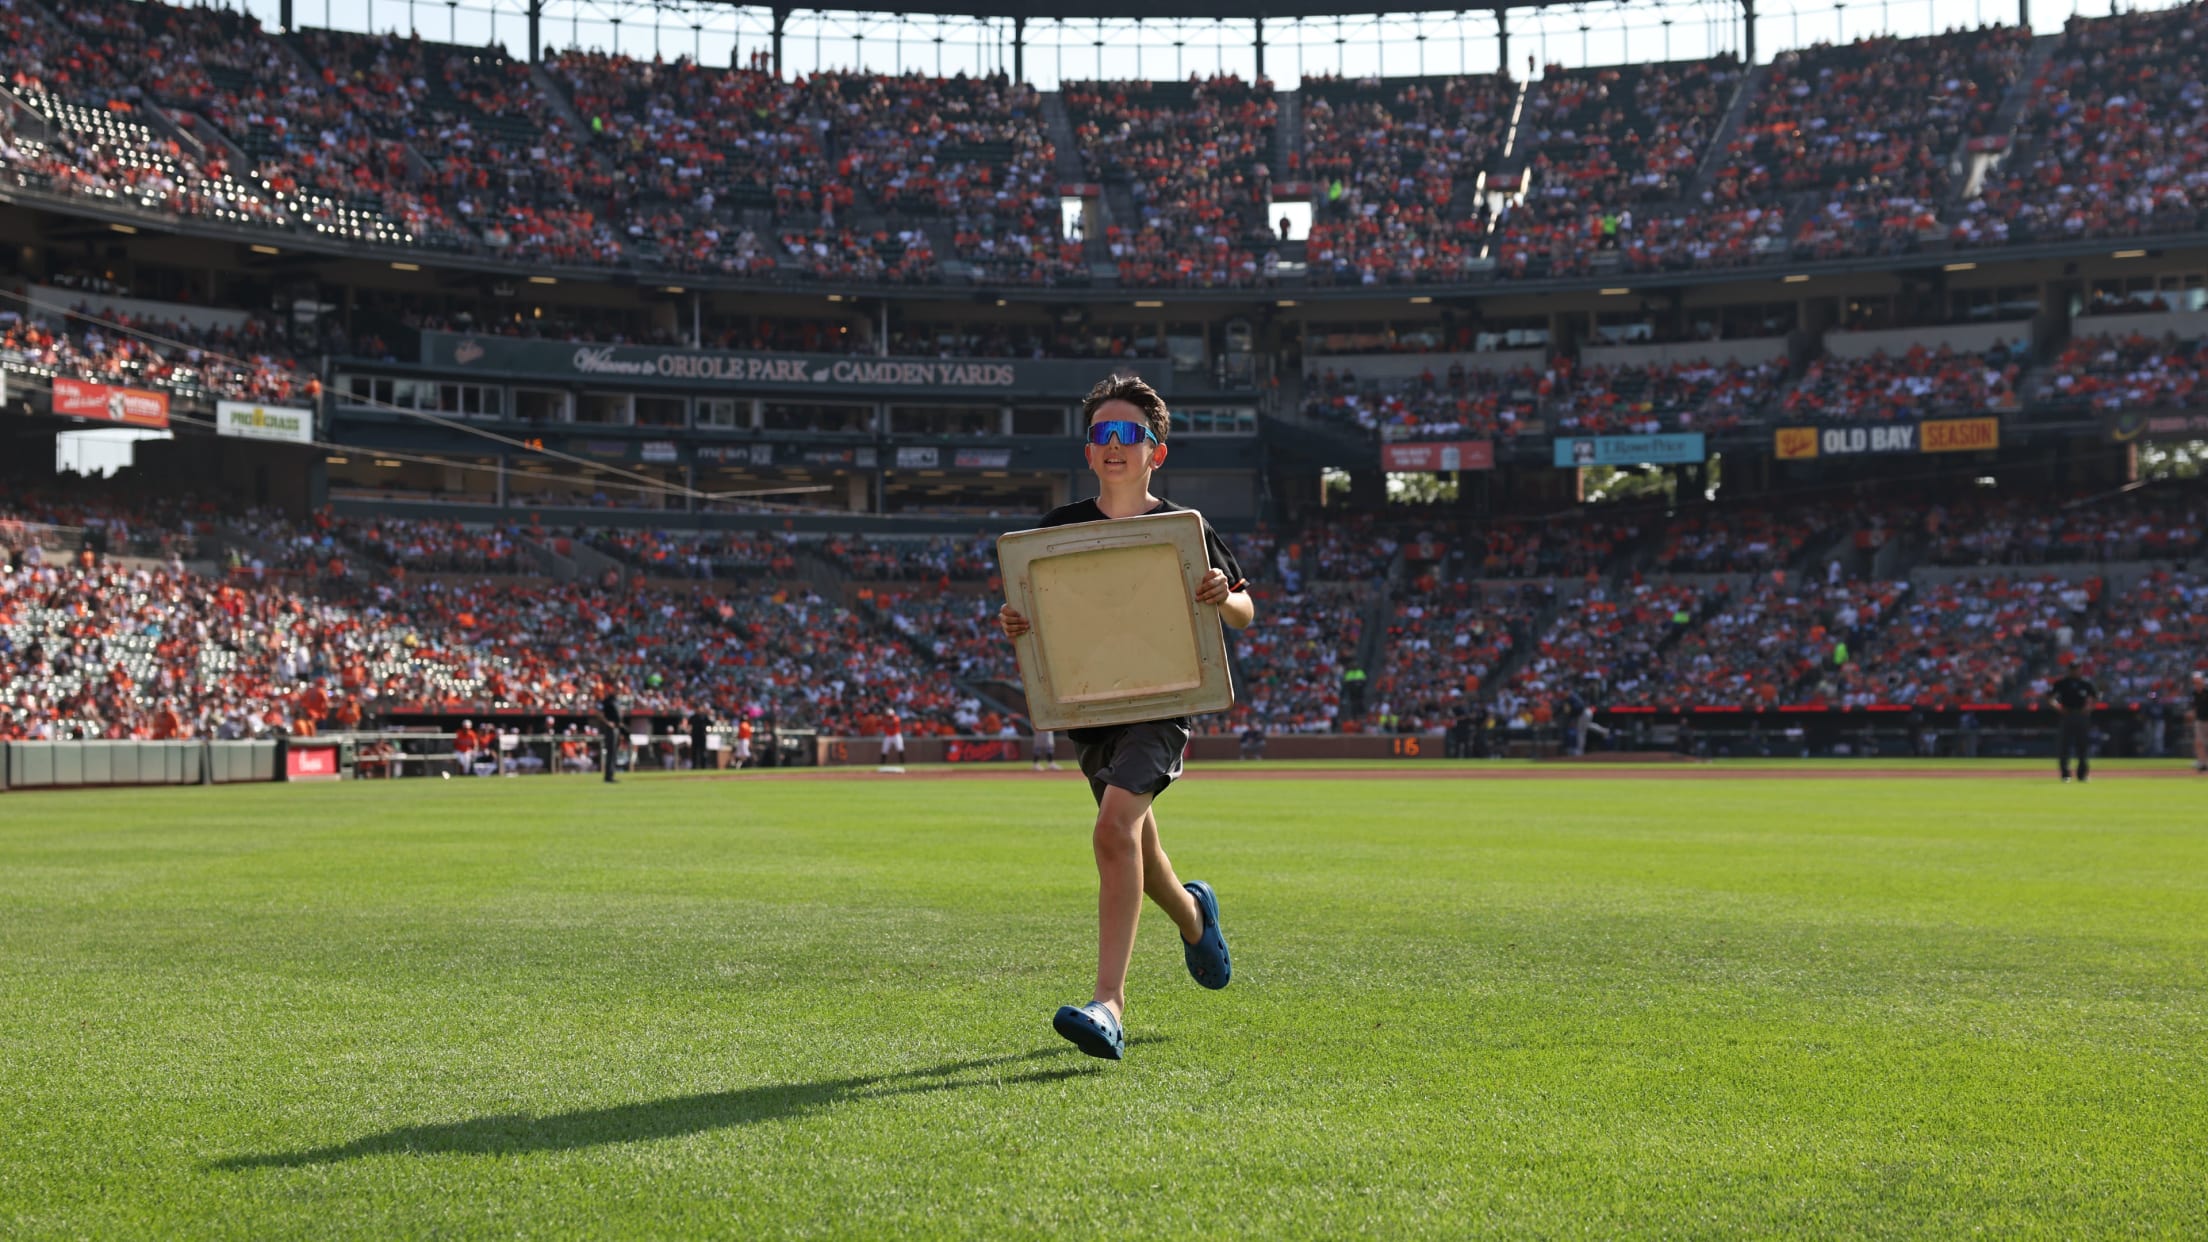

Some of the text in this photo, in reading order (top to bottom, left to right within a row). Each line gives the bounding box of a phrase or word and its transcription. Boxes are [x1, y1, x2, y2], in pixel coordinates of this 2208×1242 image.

[657, 353, 745, 379] ORIOLE
[747, 357, 809, 382] PARK
[832, 360, 935, 384] CAMDEN
[938, 363, 1014, 386] YARDS
[1823, 427, 1867, 454] OLD
[1871, 425, 1914, 452] BAY
[1927, 422, 1993, 448] SEASON
